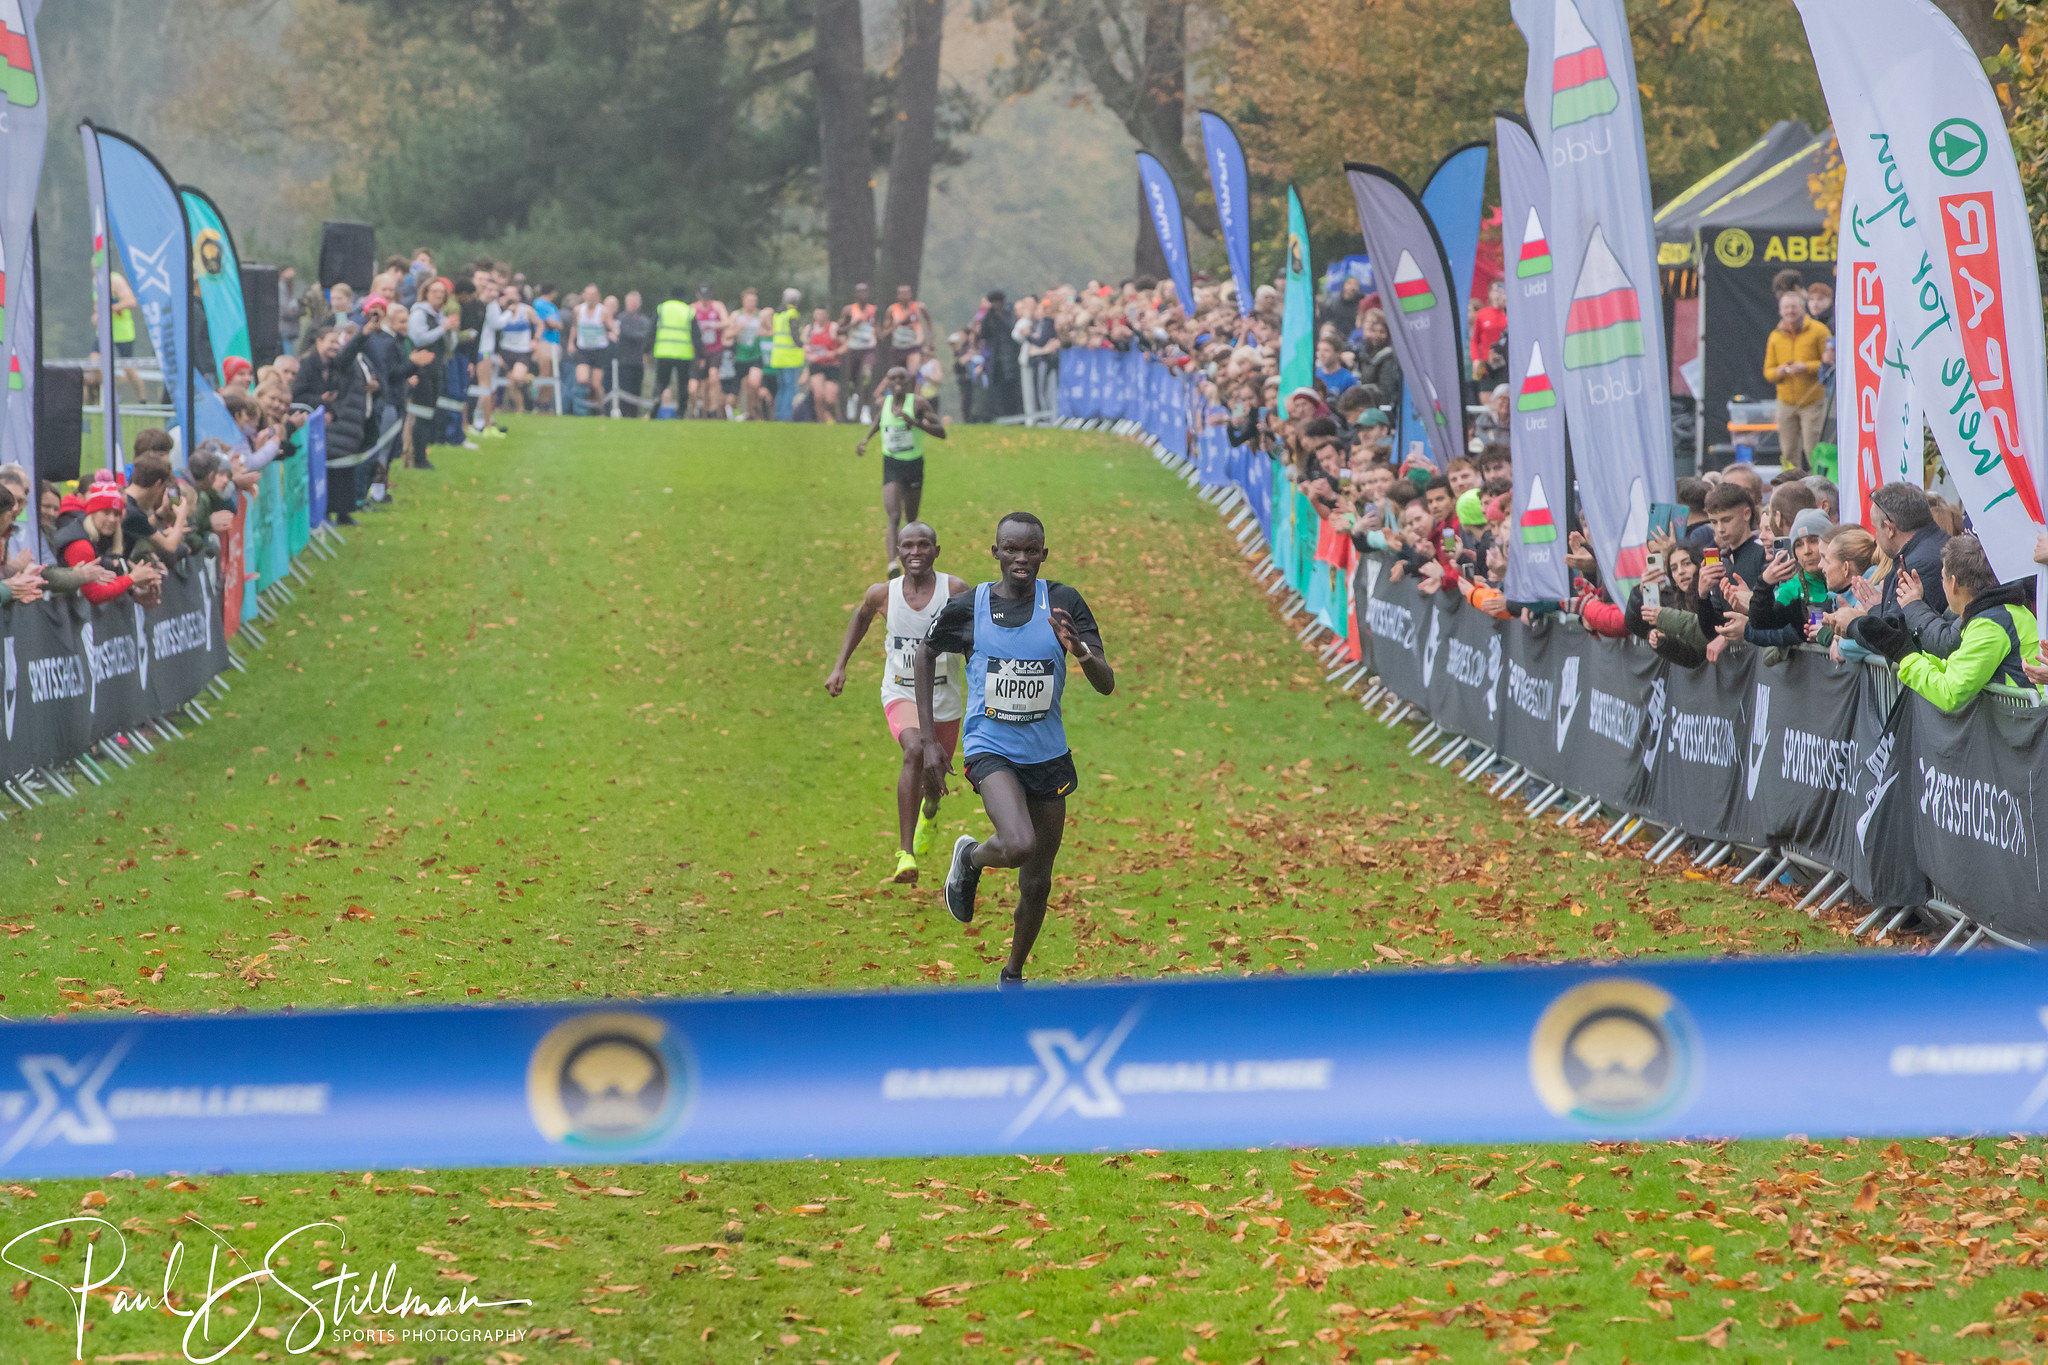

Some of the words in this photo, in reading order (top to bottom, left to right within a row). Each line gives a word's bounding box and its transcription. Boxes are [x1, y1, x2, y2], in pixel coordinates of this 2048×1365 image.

[1763, 235, 1837, 263] ABE
[1016, 660, 1044, 671] UKA
[995, 678, 1044, 699] KIPROP
